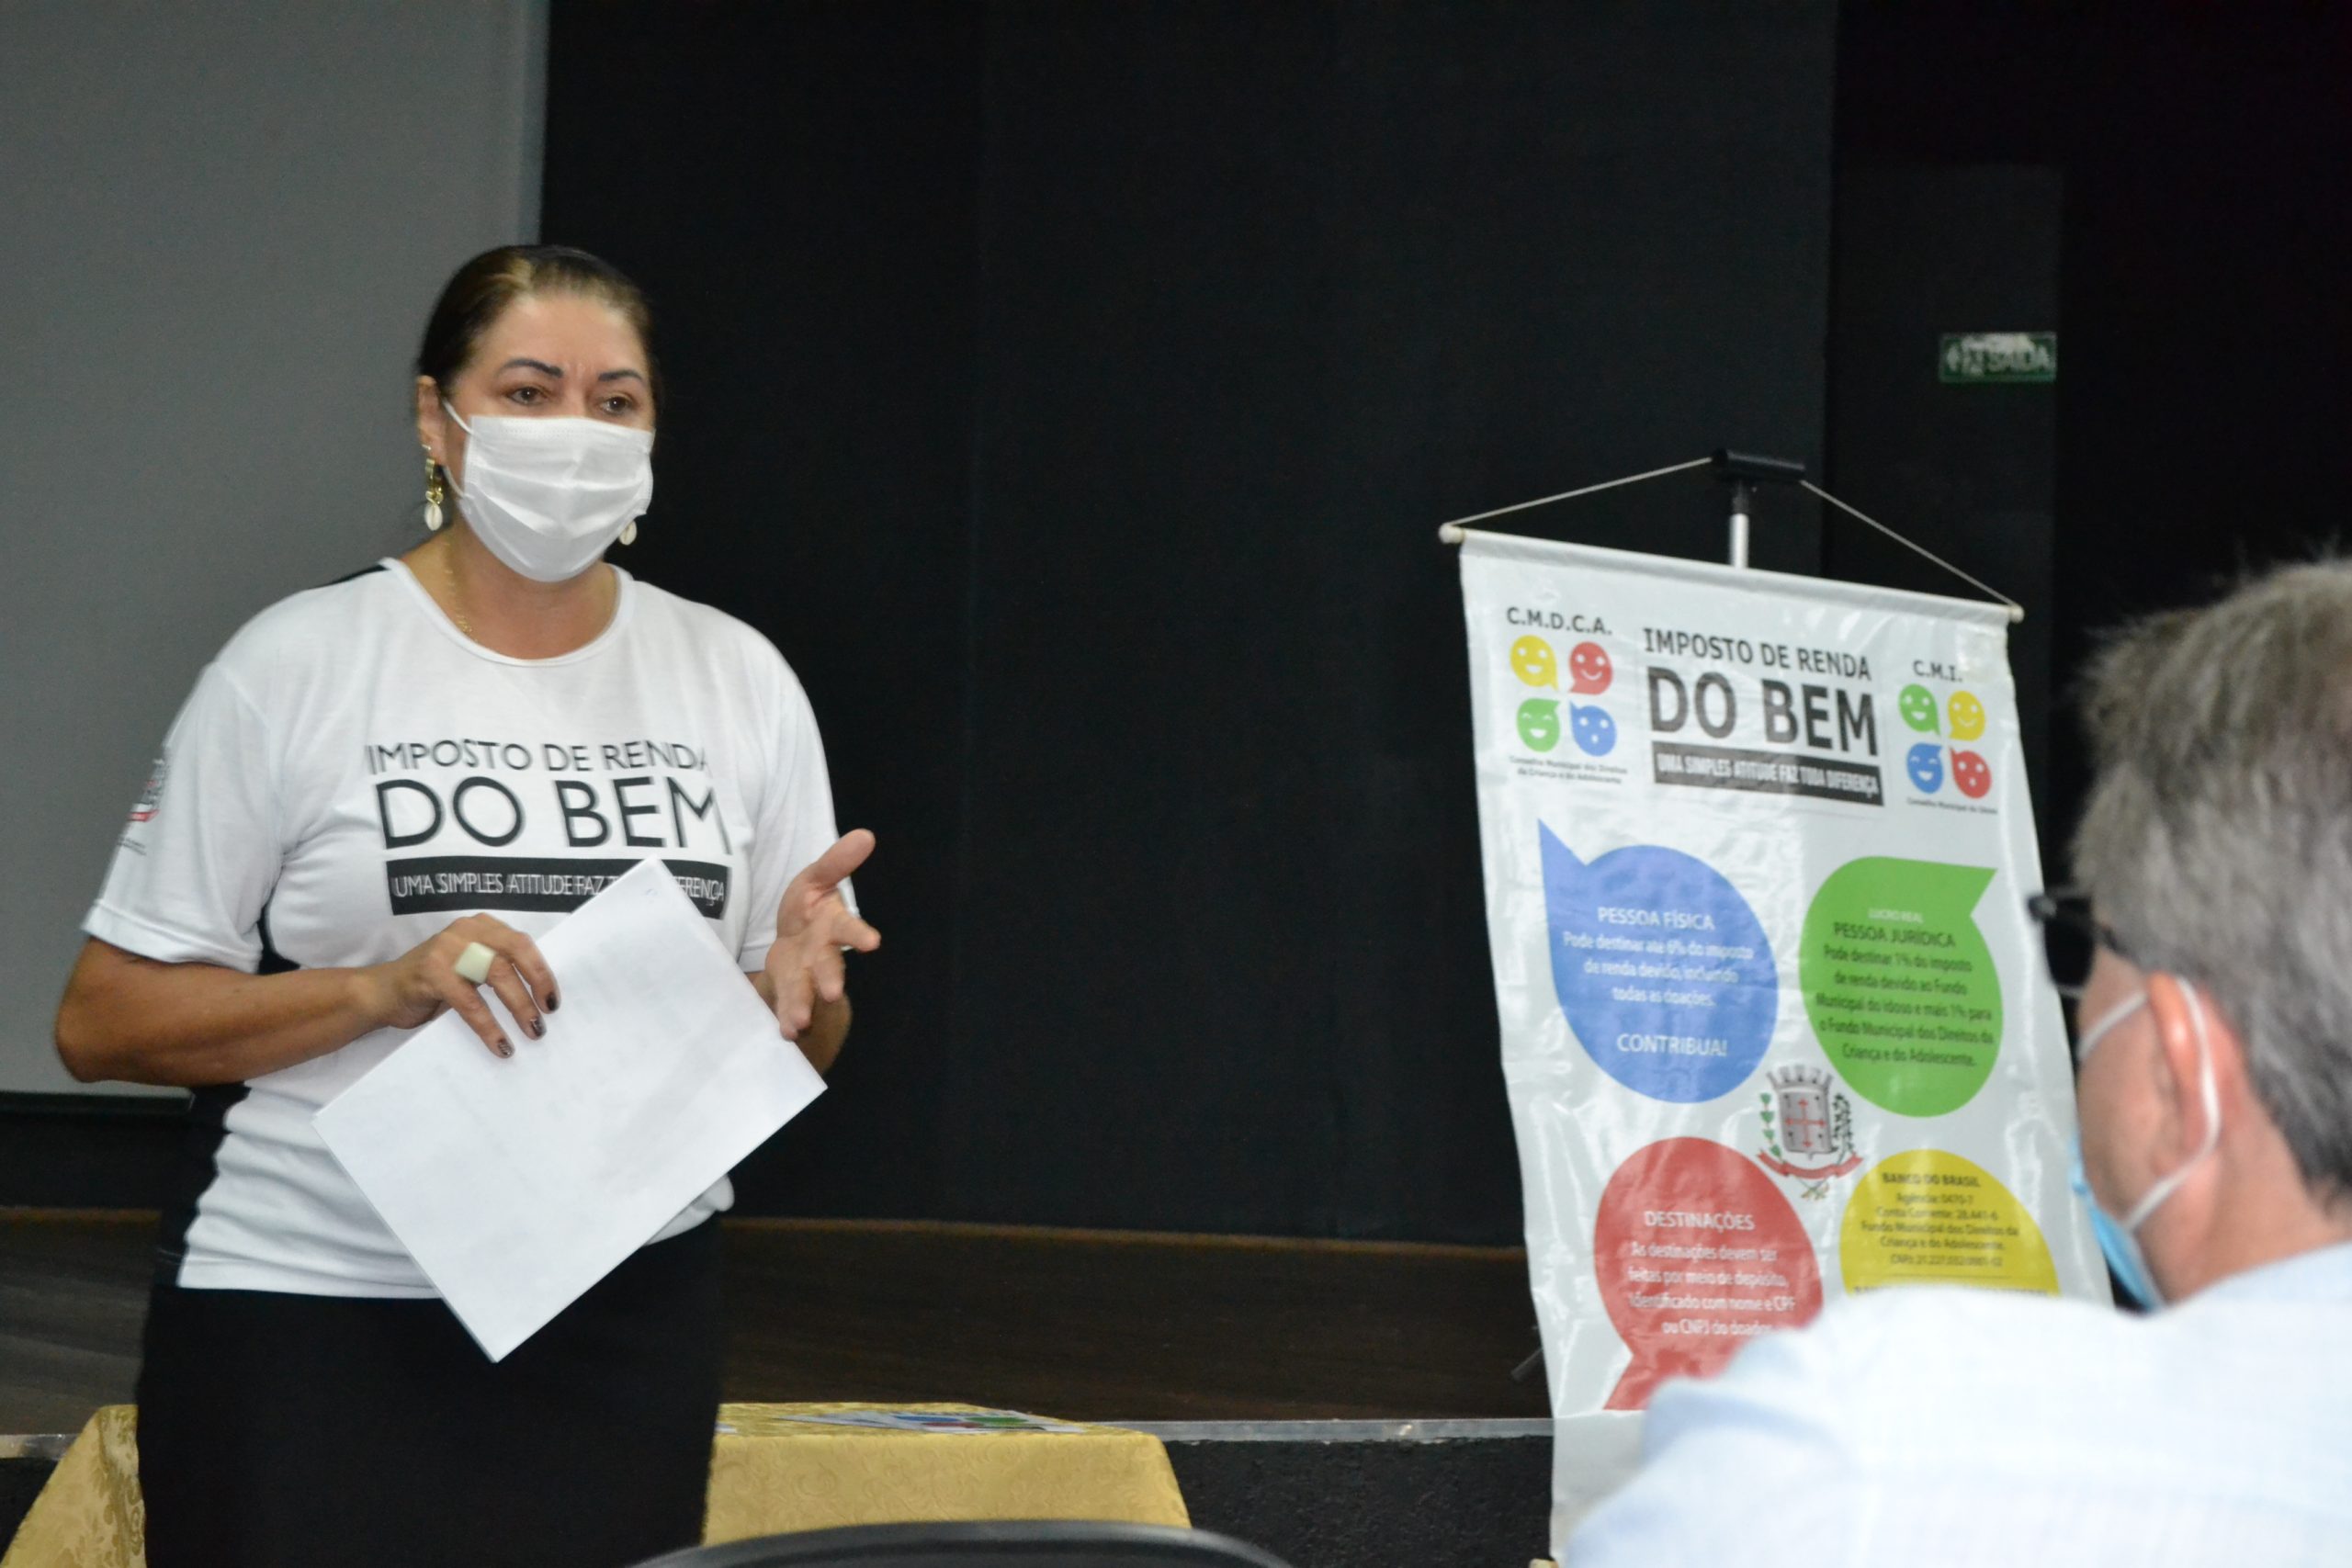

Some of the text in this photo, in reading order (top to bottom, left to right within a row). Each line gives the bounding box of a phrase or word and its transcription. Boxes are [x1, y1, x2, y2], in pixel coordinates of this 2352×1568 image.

[1506, 606, 1612, 636] C.M.D.C.A.
[1643, 627, 1872, 682] IMPOSTO DE RENDA
[1913, 660, 1962, 682] C.M.I.
[1647, 666, 1879, 757] DO BEM
[367, 739, 709, 775] IMPOSTO DE RENDA
[1657, 752, 1684, 773] UMA
[1684, 754, 1732, 778] SIMPLES
[375, 775, 734, 856] DO BEM
[392, 874, 435, 897] UMA
[436, 873, 503, 894] SIMPLES
[505, 874, 573, 895] ATITUDE
[575, 874, 603, 897] FAZ
[1597, 906, 1715, 931] PESSOA FÍSICA
[1563, 931, 1595, 950] Pode
[1596, 933, 1644, 953] destinar
[1688, 940, 1704, 956] do
[1833, 921, 1887, 942] PESSOA
[1616, 1033, 1729, 1057] CONTRIBUA!
[1644, 1211, 1756, 1235] DESTINAÇÕES
